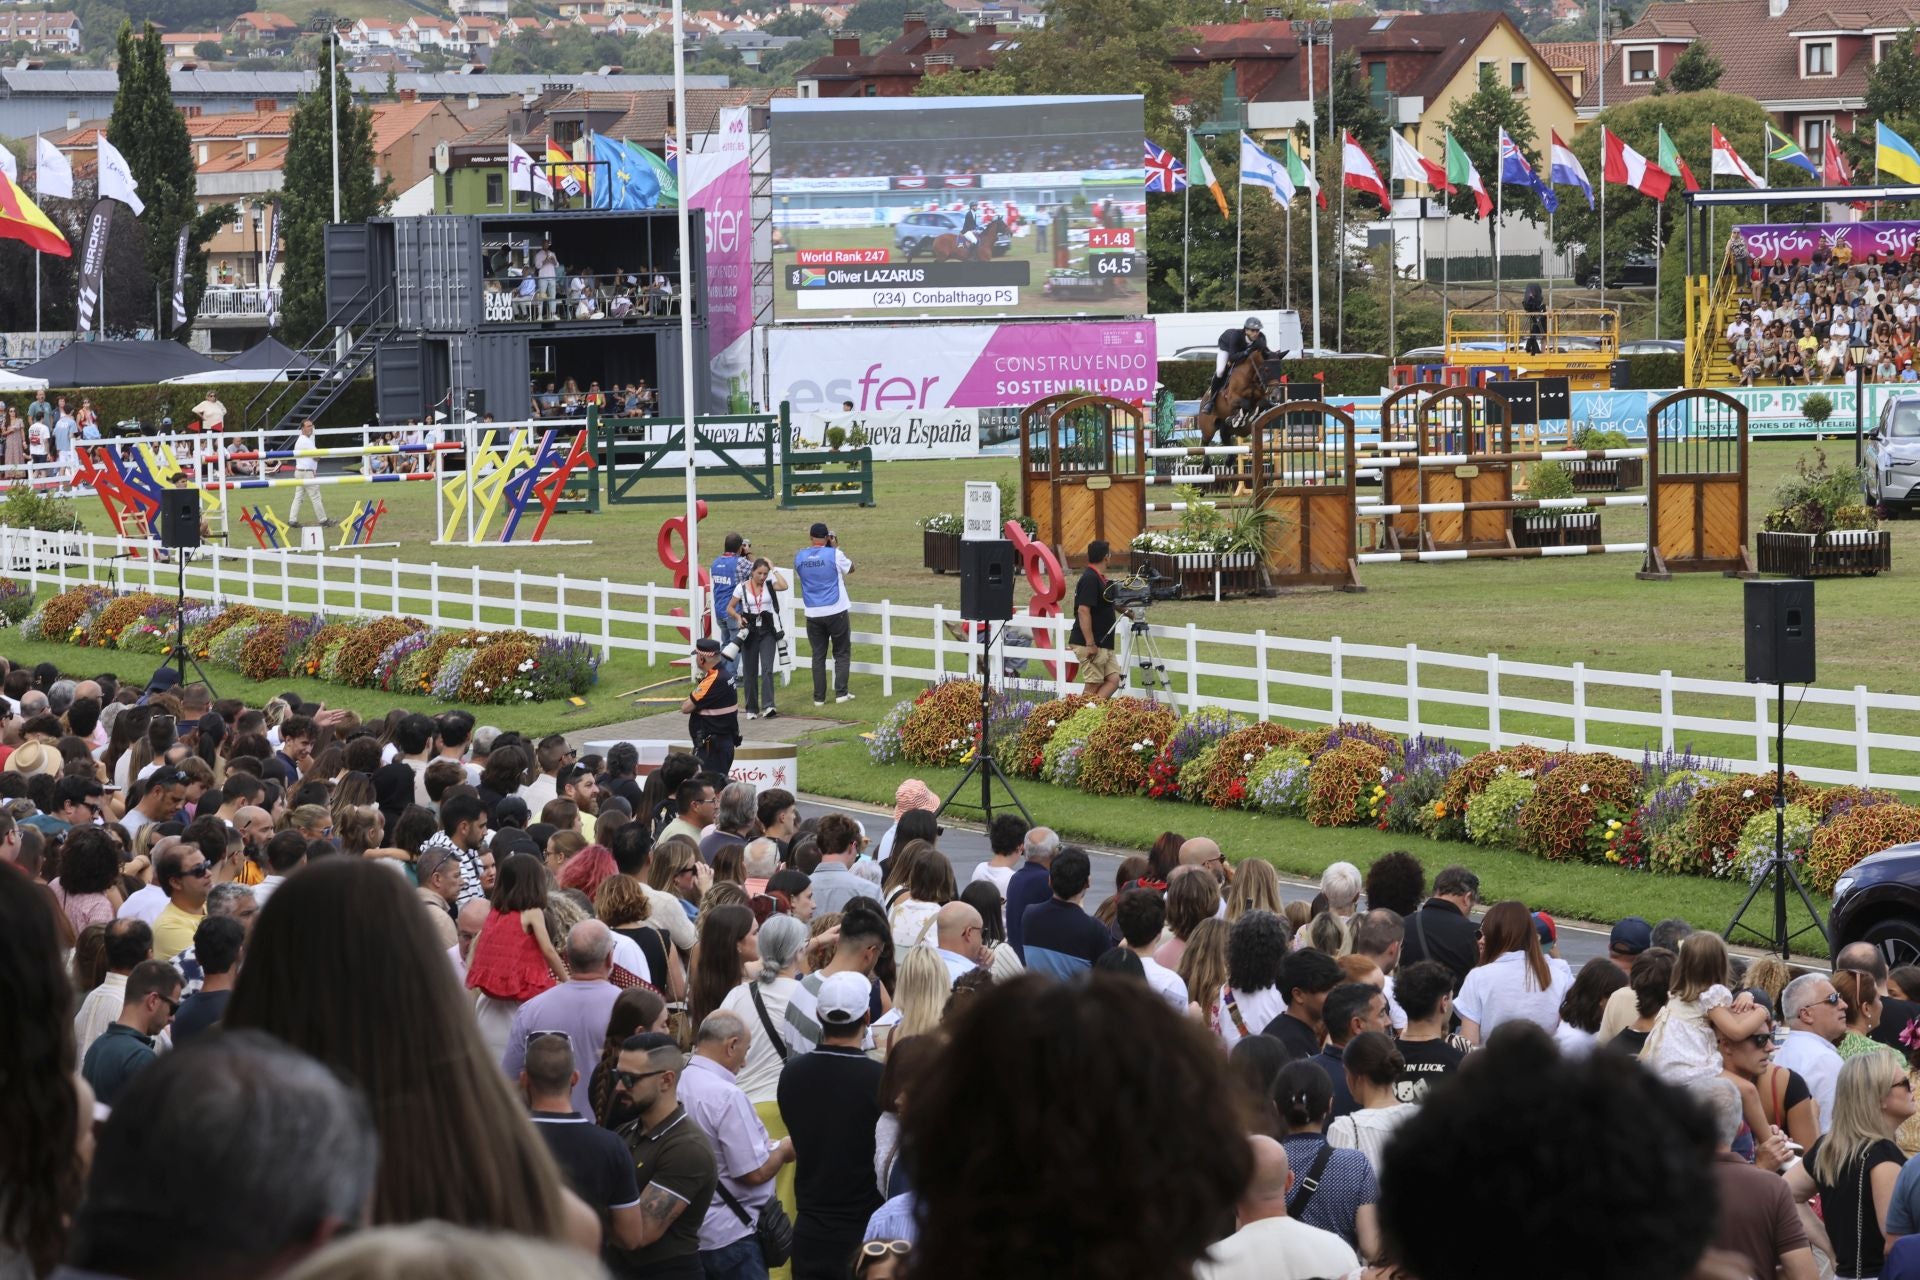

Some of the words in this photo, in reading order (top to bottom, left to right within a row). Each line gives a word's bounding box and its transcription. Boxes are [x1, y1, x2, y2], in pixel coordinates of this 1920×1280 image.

[84, 214, 102, 275] SIROKO
[1093, 233, 1130, 246] +1.48
[1748, 230, 1813, 260] gijón
[801, 251, 832, 263] World
[835, 251, 862, 262] Rank
[865, 250, 886, 262] 247
[1097, 258, 1132, 273] 64.5
[792, 270, 801, 285] RSA
[828, 270, 861, 284] Oliver
[864, 269, 925, 283] LAZARUS
[486, 292, 512, 307] RAW
[873, 292, 906, 307] (234)
[913, 290, 992, 306] Conbalthago
[995, 290, 1012, 302] PS
[486, 307, 513, 321] COCO
[995, 354, 1147, 372] CONSTRUYENDO
[785, 363, 940, 412] esfer
[996, 378, 1148, 395] SOSTENIBILIDAD
[905, 418, 972, 448] España
[1600, 421, 1618, 432] DEL
[310, 532, 316, 545] 1
[728, 766, 768, 783] gijón
[1406, 1063, 1417, 1072] IN
[1418, 1063, 1446, 1072] LUCK
